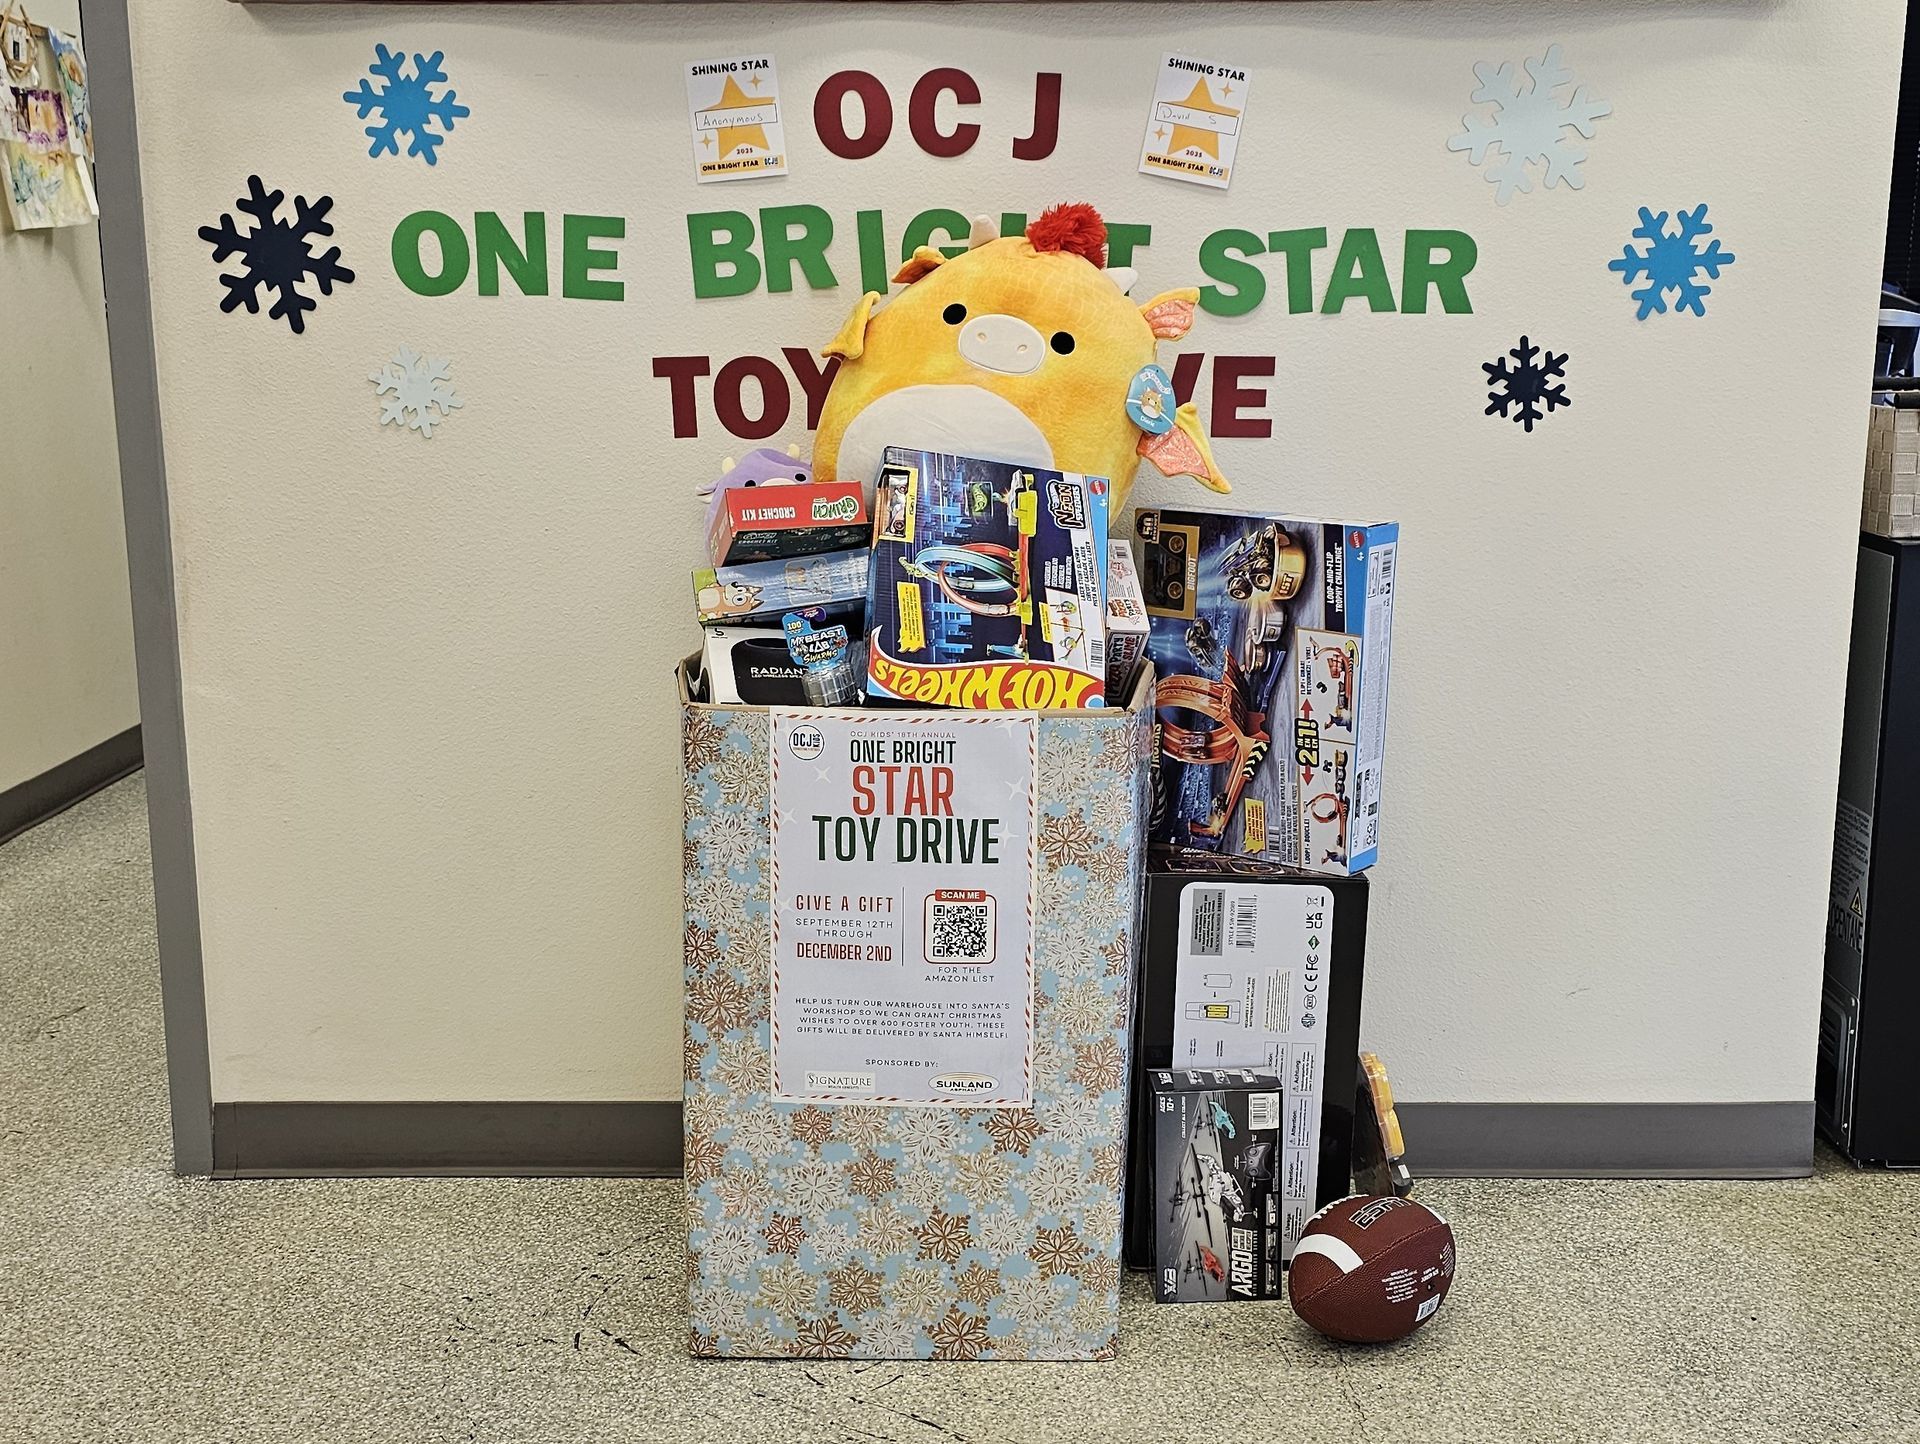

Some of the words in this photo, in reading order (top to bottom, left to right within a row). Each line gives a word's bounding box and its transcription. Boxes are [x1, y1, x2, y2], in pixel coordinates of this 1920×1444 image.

[692, 62, 738, 76] SHINING
[741, 60, 769, 71] STAR
[1168, 58, 1214, 75] SHINING
[1218, 68, 1245, 81] STAR
[703, 113, 764, 130] Anonymous
[702, 164, 716, 172] ONE
[718, 162, 740, 170] BRIGHT
[1148, 155, 1161, 164] ONE
[1162, 158, 1186, 168] BRIGHT
[1188, 164, 1204, 172] STAR
[391, 210, 626, 301] ONE
[1199, 226, 1478, 316] STAR
[652, 347, 846, 440] TOY
[742, 508, 757, 522] KIT
[758, 506, 795, 520] CROCHET
[1187, 556, 1197, 591] BIGFOOT
[1326, 552, 1334, 604] LOOP-AND-FLIP
[809, 641, 830, 653] LAB
[1110, 637, 1124, 663] PARTY
[804, 650, 838, 664] SWARMS
[793, 732, 812, 746] OCJ
[850, 740, 886, 764] ONE
[893, 740, 956, 764] BRIGHT
[1299, 749, 1318, 766] 2
[852, 765, 954, 816] STAR
[812, 815, 880, 862] TOY
[896, 817, 1000, 864] DRIVE
[941, 890, 965, 900] SCAN
[967, 890, 980, 900] ME
[796, 894, 832, 911] GIVE
[841, 896, 850, 912] A
[859, 896, 893, 913] GIFT
[796, 918, 862, 928] SEPTEMBER
[866, 920, 893, 929] 12TH
[816, 929, 873, 938] THROUGH
[796, 943, 862, 961] DECEMBER
[866, 944, 892, 962] 2ND
[938, 966, 958, 974] FOR
[962, 966, 982, 974] THE
[836, 998, 860, 1006] TURN
[886, 1001, 942, 1010] WAREHOUSE
[946, 1002, 968, 1010] INTO
[803, 1008, 856, 1016] WORKSHOP
[892, 1010, 911, 1018] CAN
[800, 1016, 834, 1024] WISHES
[854, 1018, 877, 1026] OVER
[902, 1020, 936, 1028] FOSTER
[796, 1026, 822, 1034] GIFTS
[866, 1028, 915, 1037] DELIVERED
[918, 1030, 930, 1038] BY
[933, 1030, 962, 1038] SANTA
[866, 1058, 921, 1067] SPONSORED
[924, 1060, 938, 1068] BY:
[807, 1073, 872, 1087] SIGNATURE
[936, 1080, 992, 1089] SUNLAND
[1166, 1096, 1174, 1112] 10+
[1348, 1196, 1412, 1230] ESPN
[1232, 1250, 1253, 1297] ARGO
